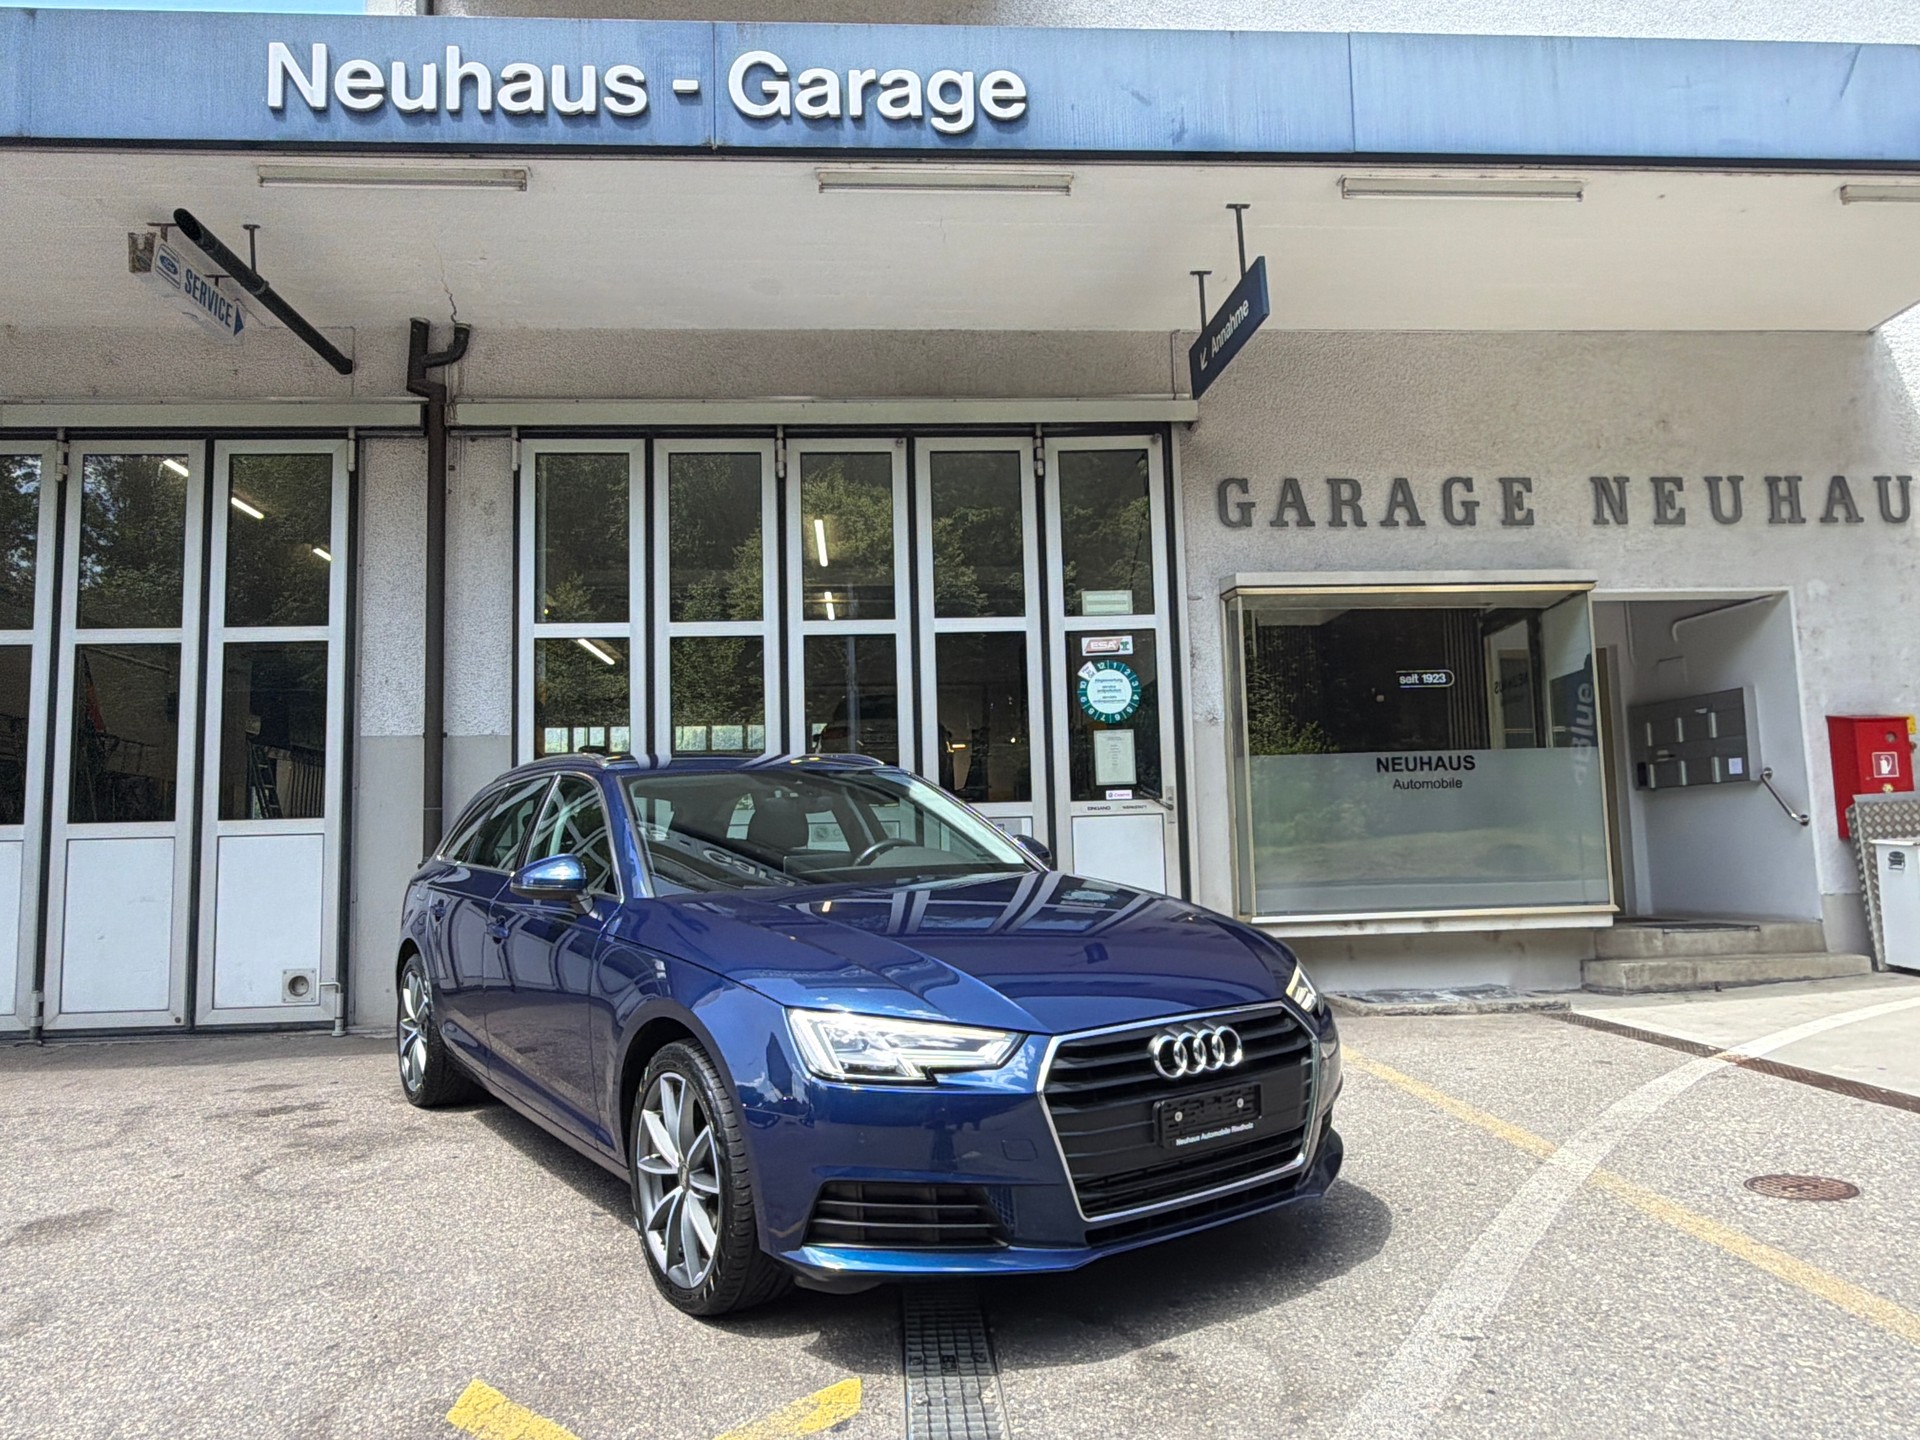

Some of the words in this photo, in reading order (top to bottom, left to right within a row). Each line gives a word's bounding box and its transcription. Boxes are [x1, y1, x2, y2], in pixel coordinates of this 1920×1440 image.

[268, 41, 649, 116] Neuhaus
[728, 50, 1028, 134] Garage
[184, 268, 233, 328] SERVICE
[1211, 299, 1250, 358] Annahme
[1217, 477, 1535, 527] GARAGE
[1590, 475, 1913, 524] NEUHAU
[1090, 641, 1117, 649] ESA
[1421, 673, 1447, 684] 1923
[1376, 755, 1476, 773] NEUHAUS
[1392, 777, 1463, 790] Automobile
